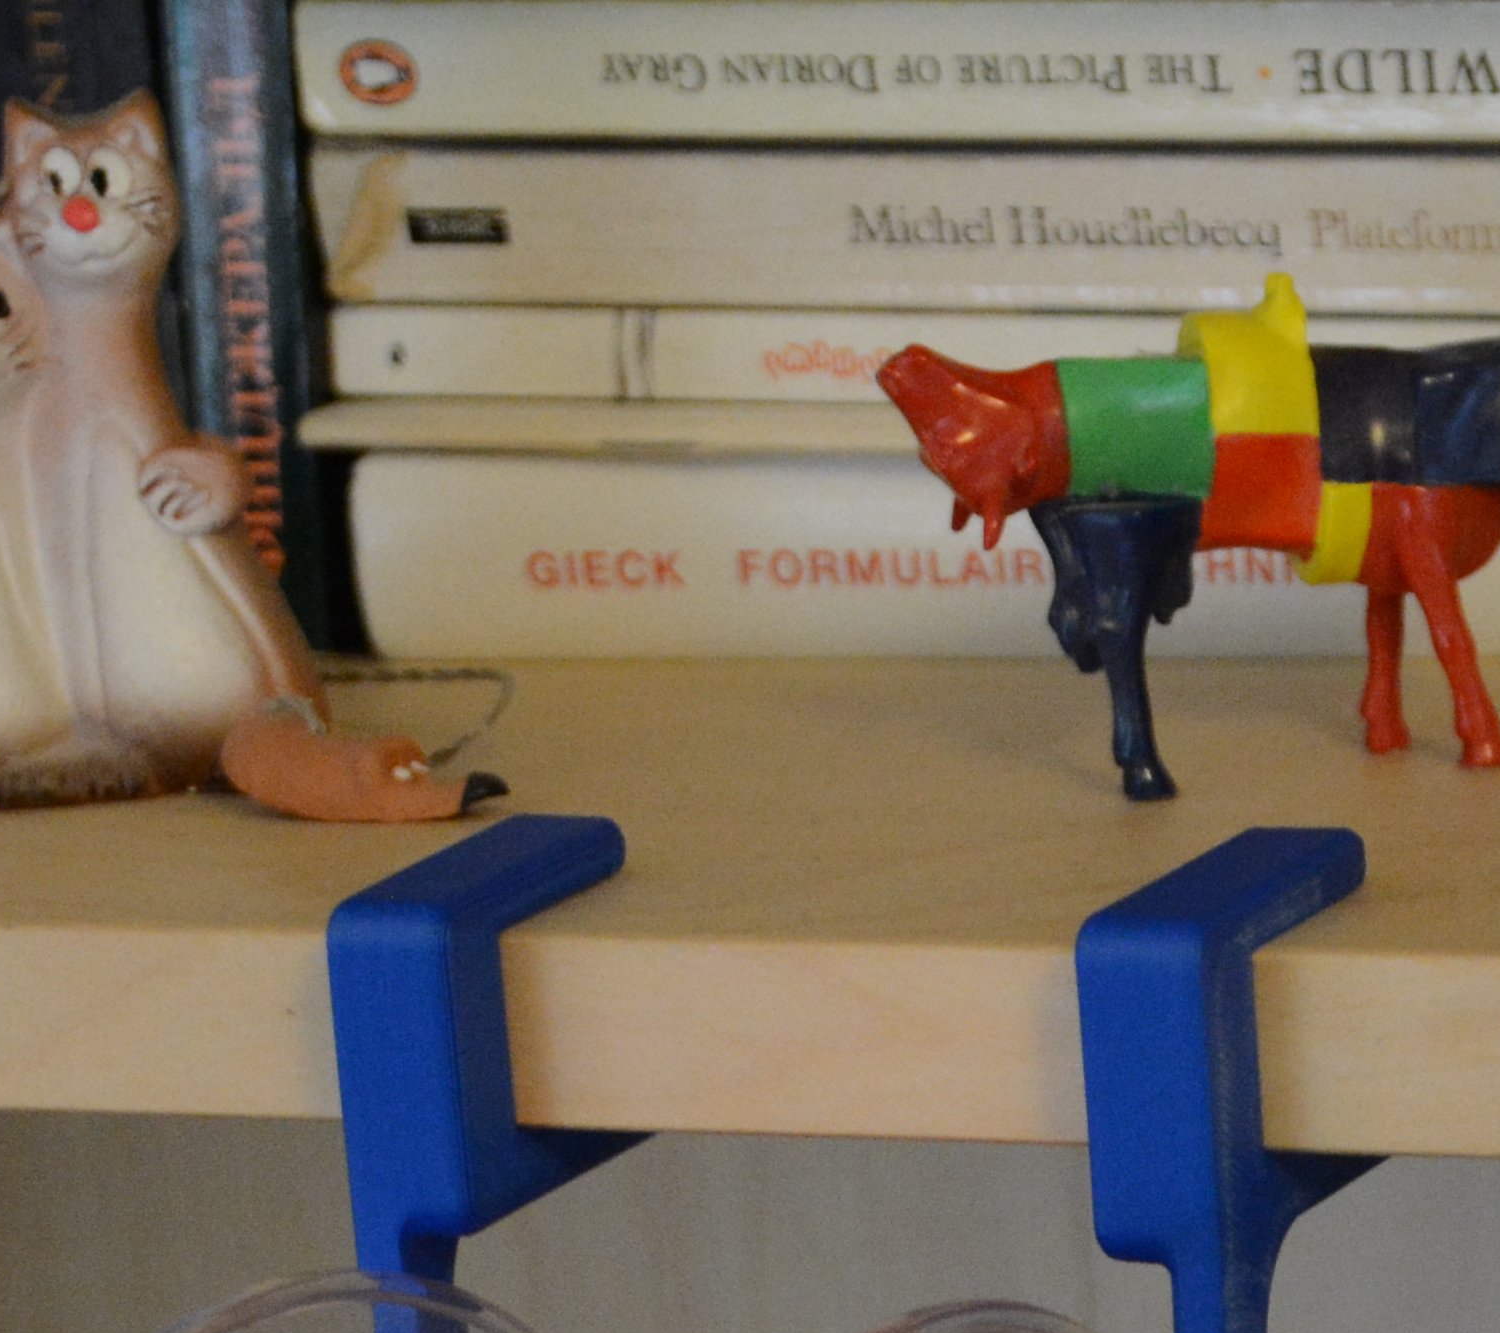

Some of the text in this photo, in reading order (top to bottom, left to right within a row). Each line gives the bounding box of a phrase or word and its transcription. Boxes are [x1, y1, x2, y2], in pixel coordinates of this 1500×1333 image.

[599, 48, 709, 92] GRAY
[721, 50, 879, 95] DORIAN
[895, 54, 942, 94] OF
[955, 53, 1129, 94] PICTURE
[1146, 53, 1231, 94] THE
[848, 204, 994, 252] Michel
[526, 546, 1045, 590] GIECK FORMULAIR
